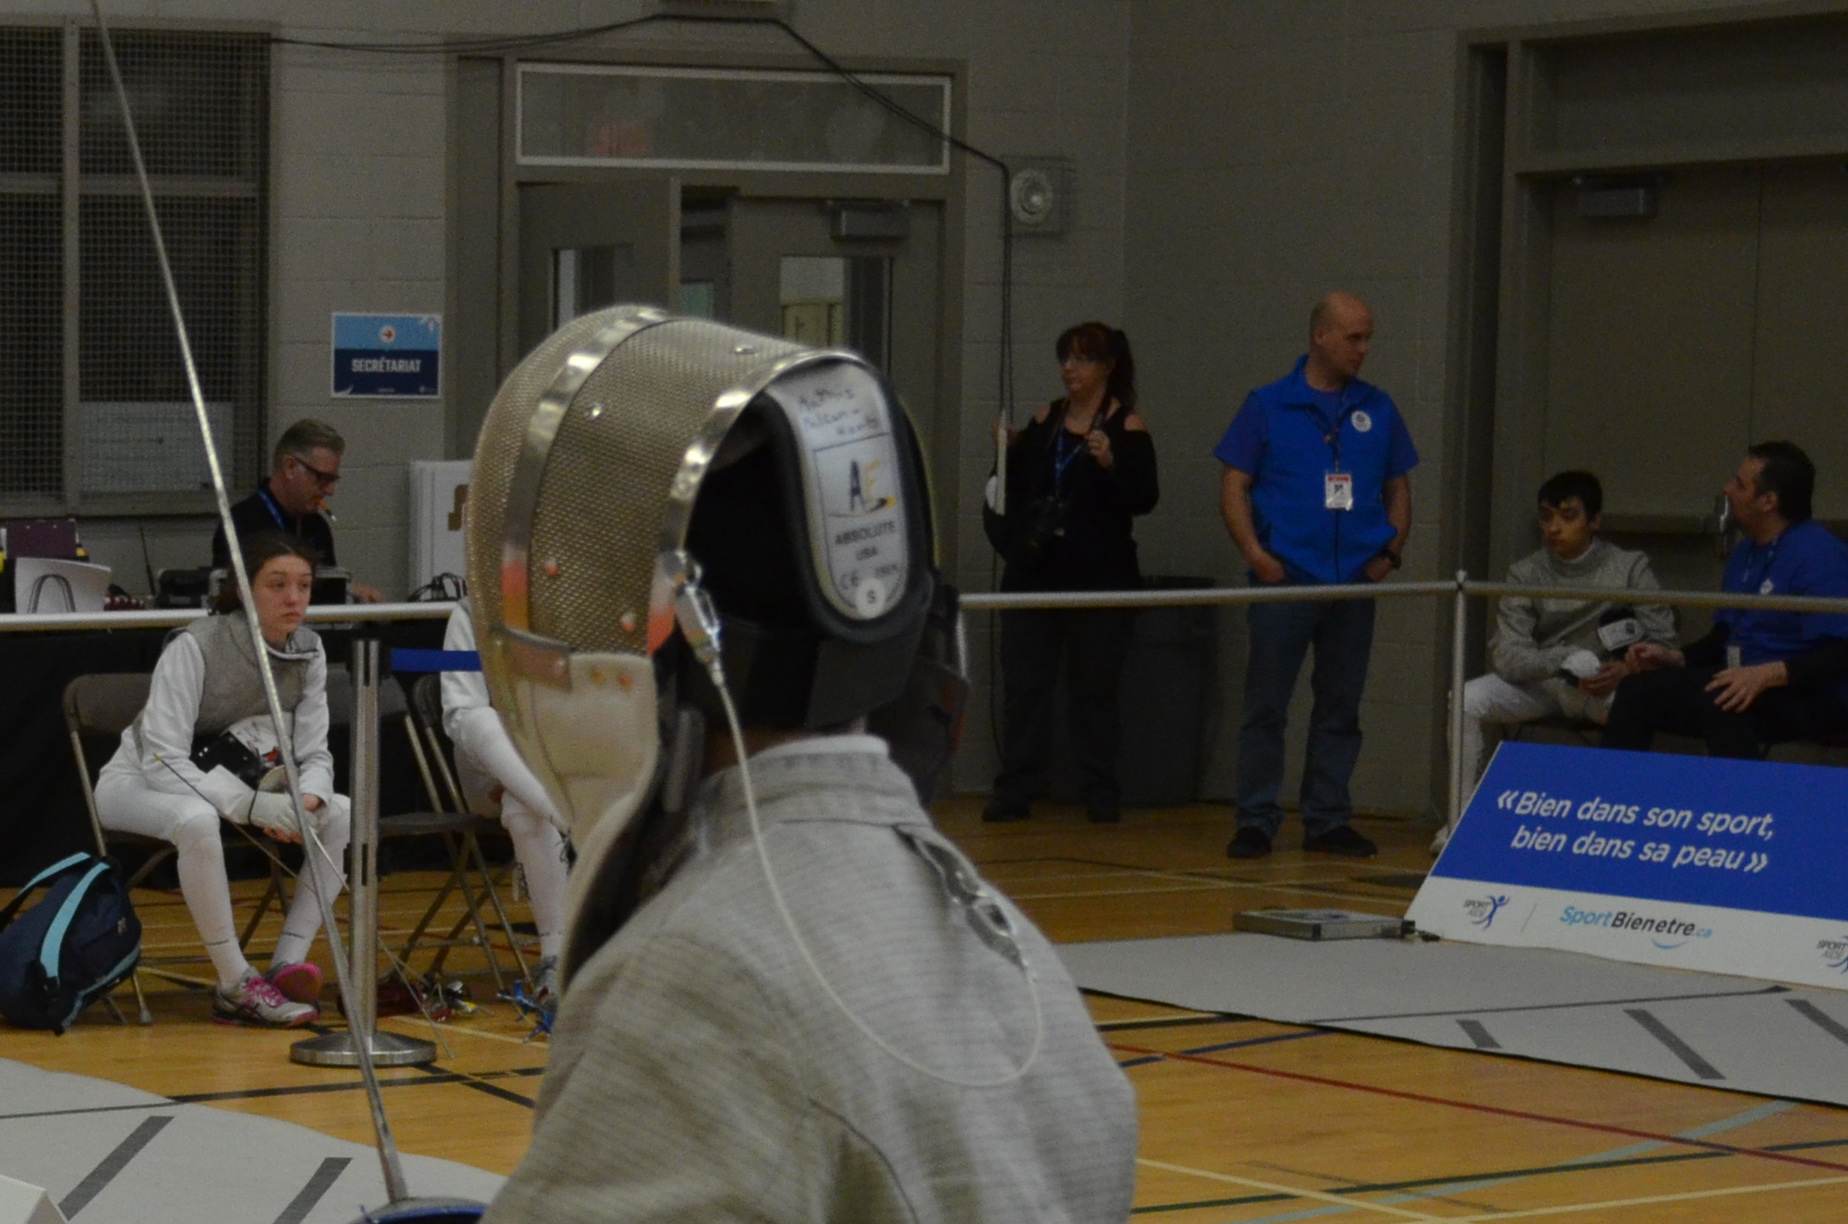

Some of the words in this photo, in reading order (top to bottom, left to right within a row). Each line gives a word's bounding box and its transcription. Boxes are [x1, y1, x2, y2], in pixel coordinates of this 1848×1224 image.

[351, 355, 422, 373] SECRÉTARIAT
[867, 590, 877, 603] S
[1576, 797, 1640, 824] dans
[1643, 807, 1693, 829] son
[1696, 812, 1775, 841] sport,
[1510, 825, 1568, 852] bien
[1572, 831, 1636, 858] dans
[1638, 843, 1671, 862] sa
[1560, 905, 1713, 939] SportBienetre.ca
